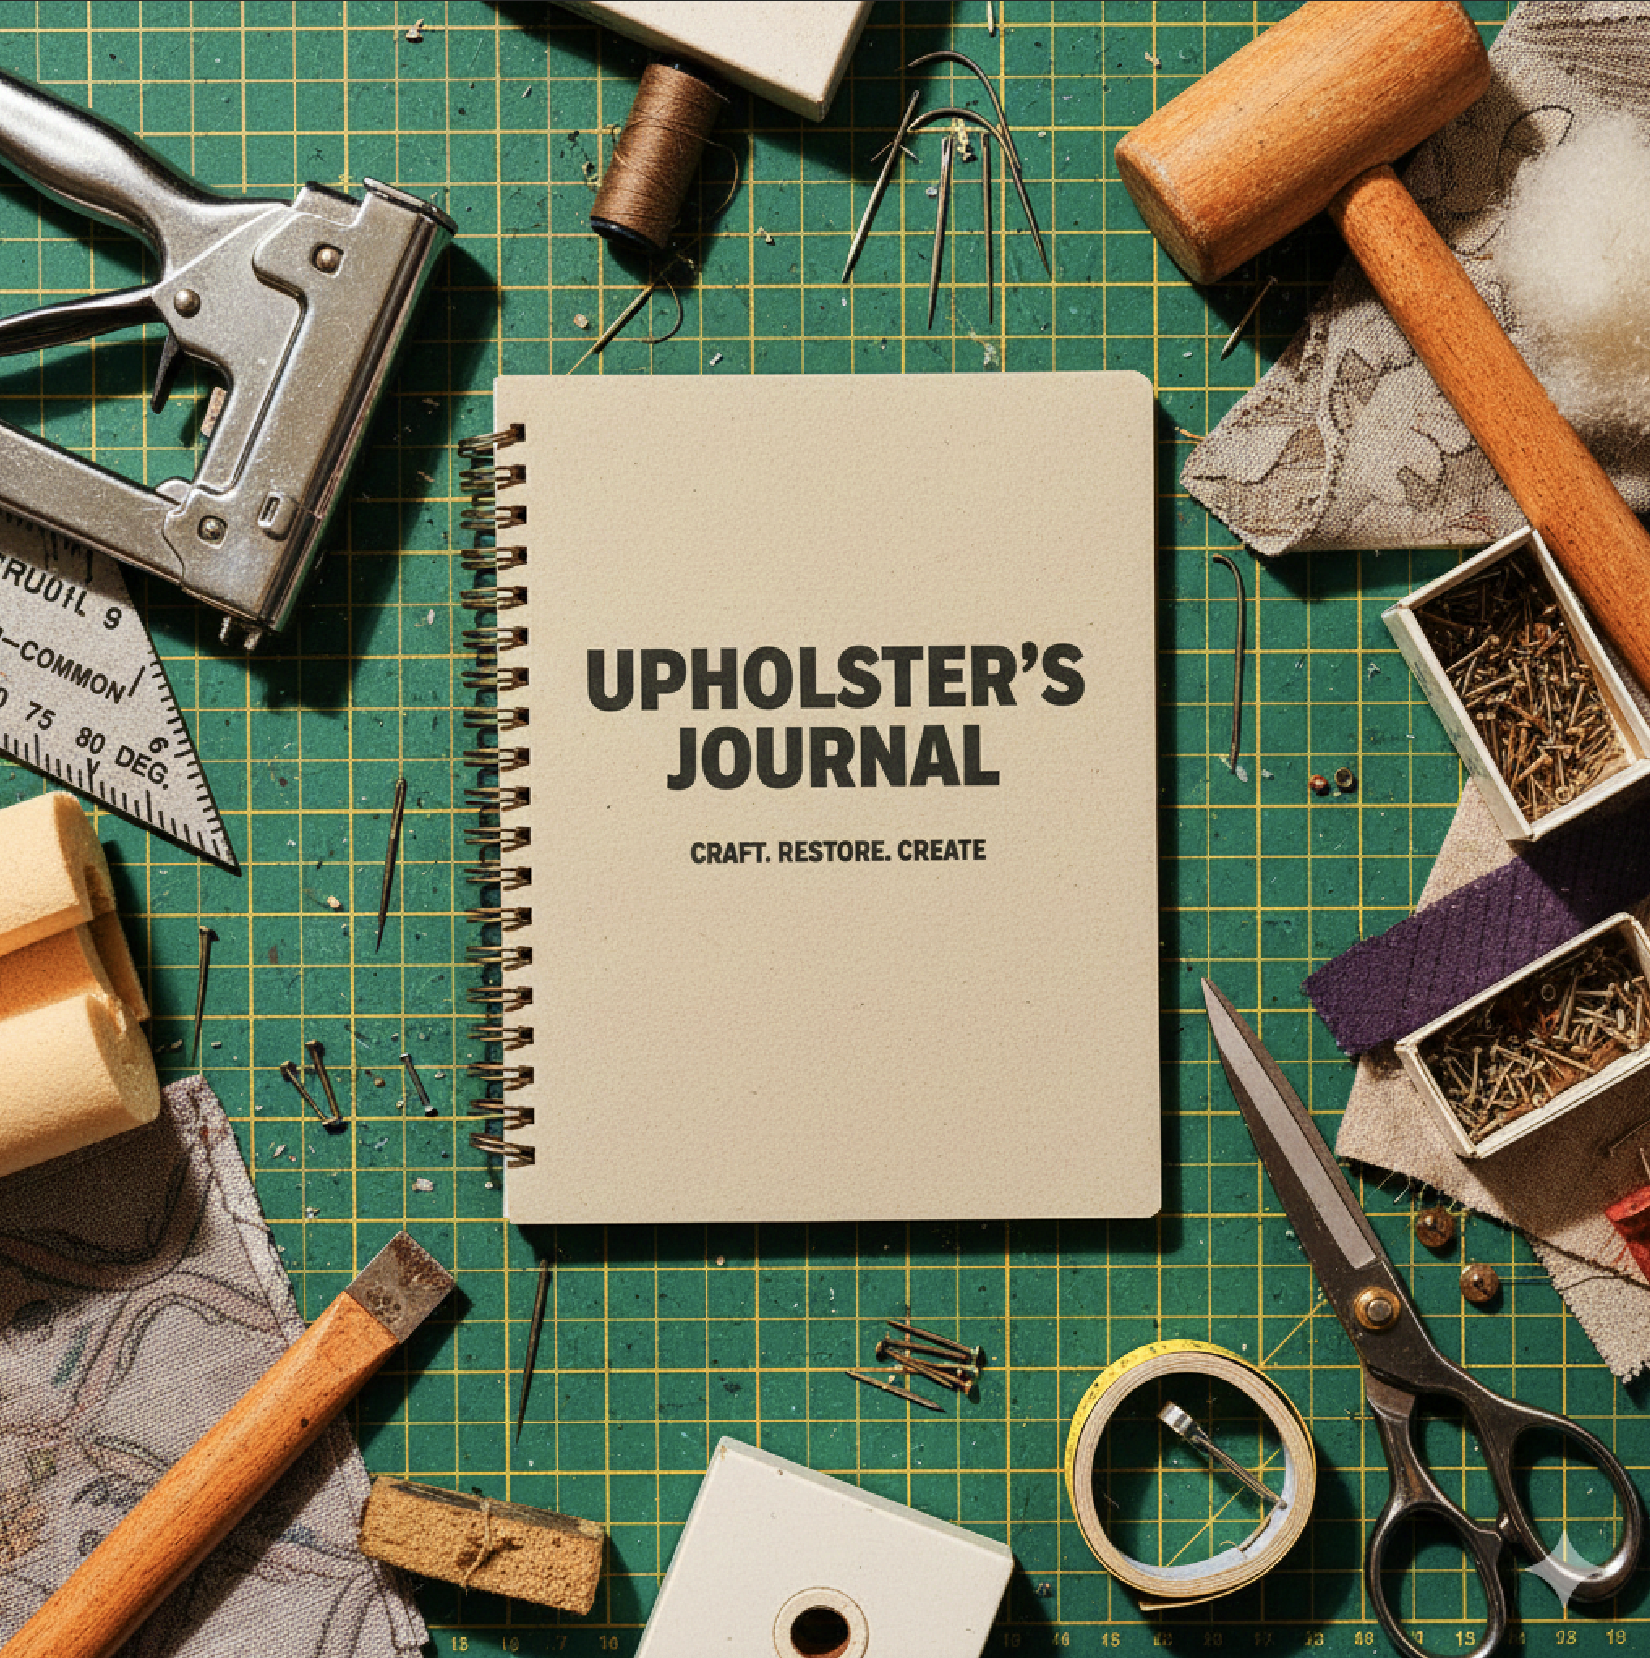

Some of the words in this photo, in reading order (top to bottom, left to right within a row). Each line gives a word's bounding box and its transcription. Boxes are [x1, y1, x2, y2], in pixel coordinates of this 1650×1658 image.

[103, 607, 122, 630] 9
[586, 640, 1086, 712] UPHOLSTER’S
[25, 700, 57, 731] 75
[75, 726, 107, 755] 80
[114, 744, 169, 791] DEG.
[666, 724, 1001, 791] JOURNAL
[690, 840, 771, 865] CRAFT.
[778, 840, 892, 864] RESTORE.
[897, 838, 987, 862] CREATE
